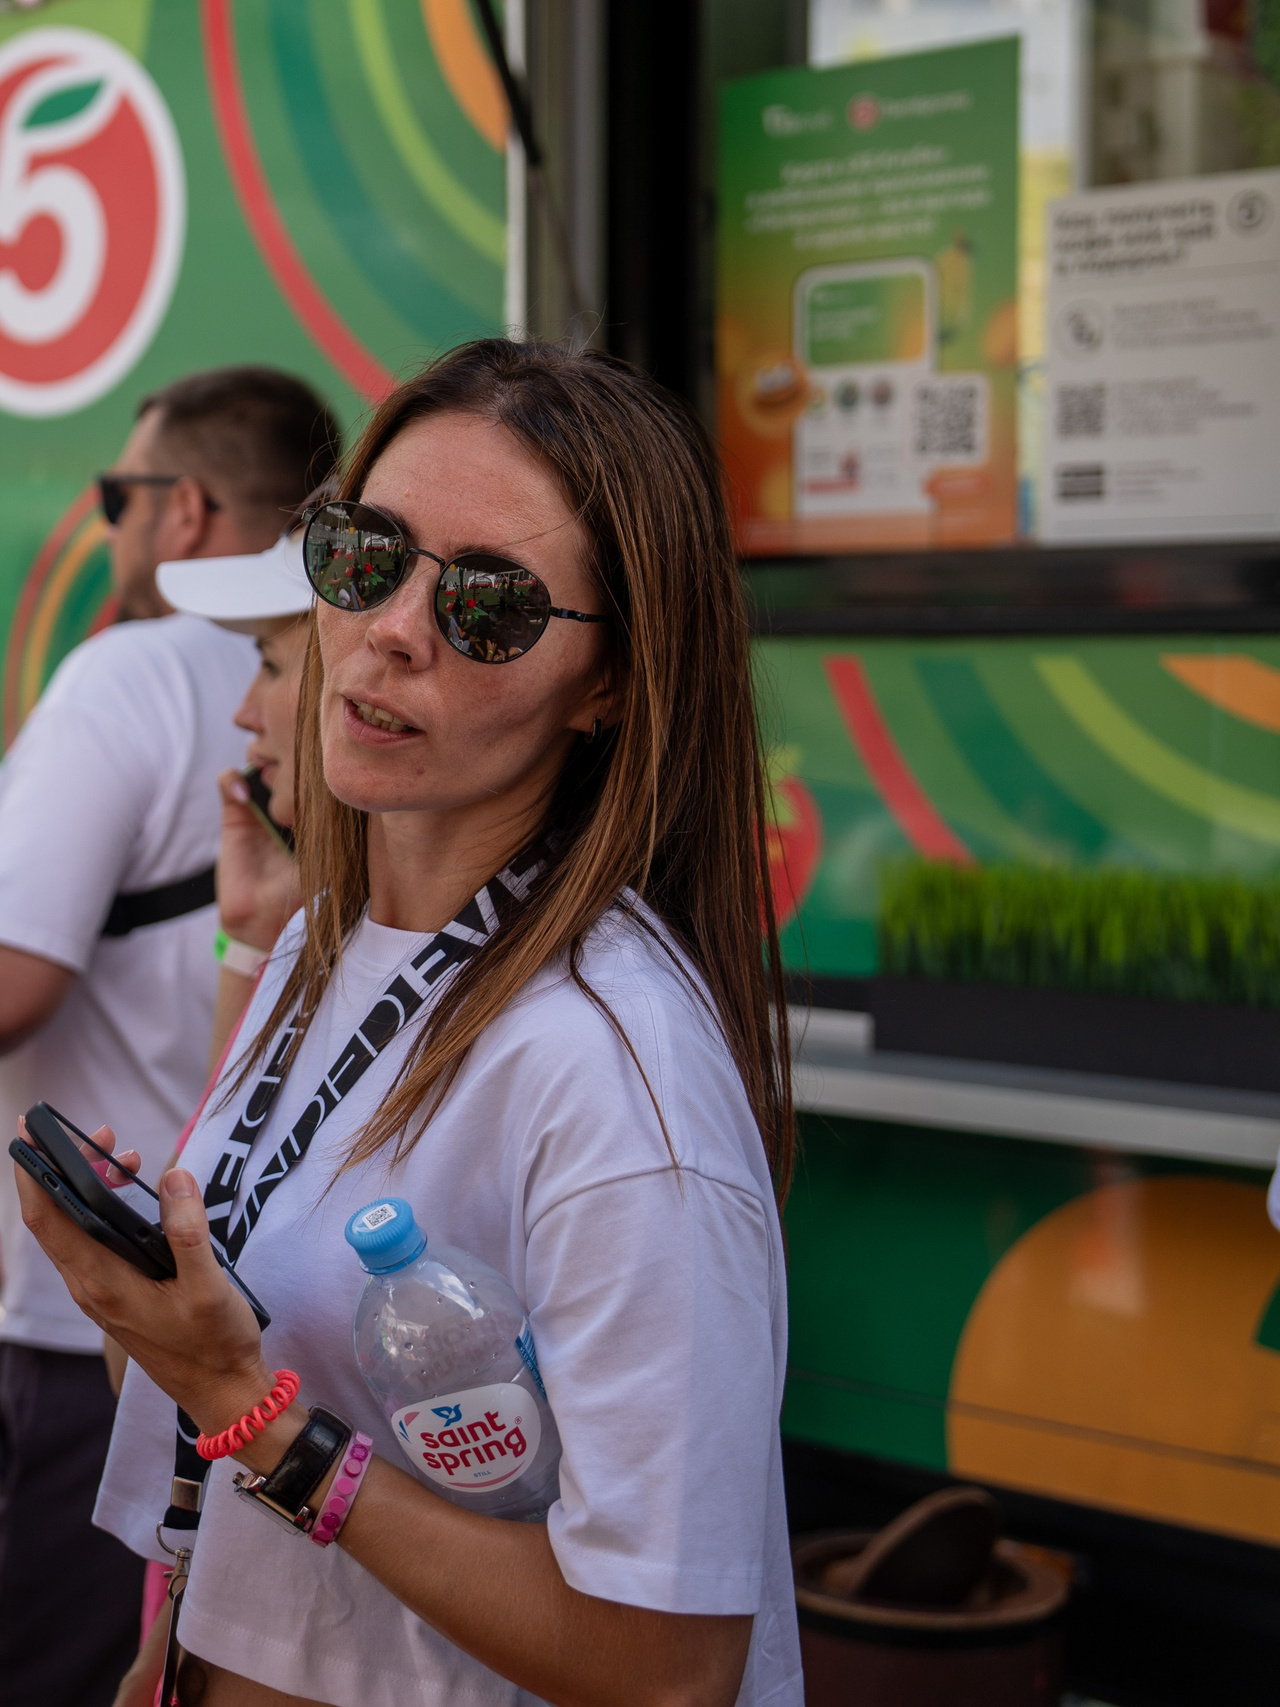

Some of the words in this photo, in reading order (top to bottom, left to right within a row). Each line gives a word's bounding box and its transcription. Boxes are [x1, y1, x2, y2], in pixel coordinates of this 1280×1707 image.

[420, 1410, 507, 1449] saint
[422, 1426, 527, 1476] spring
[472, 1470, 492, 1478] STILL
